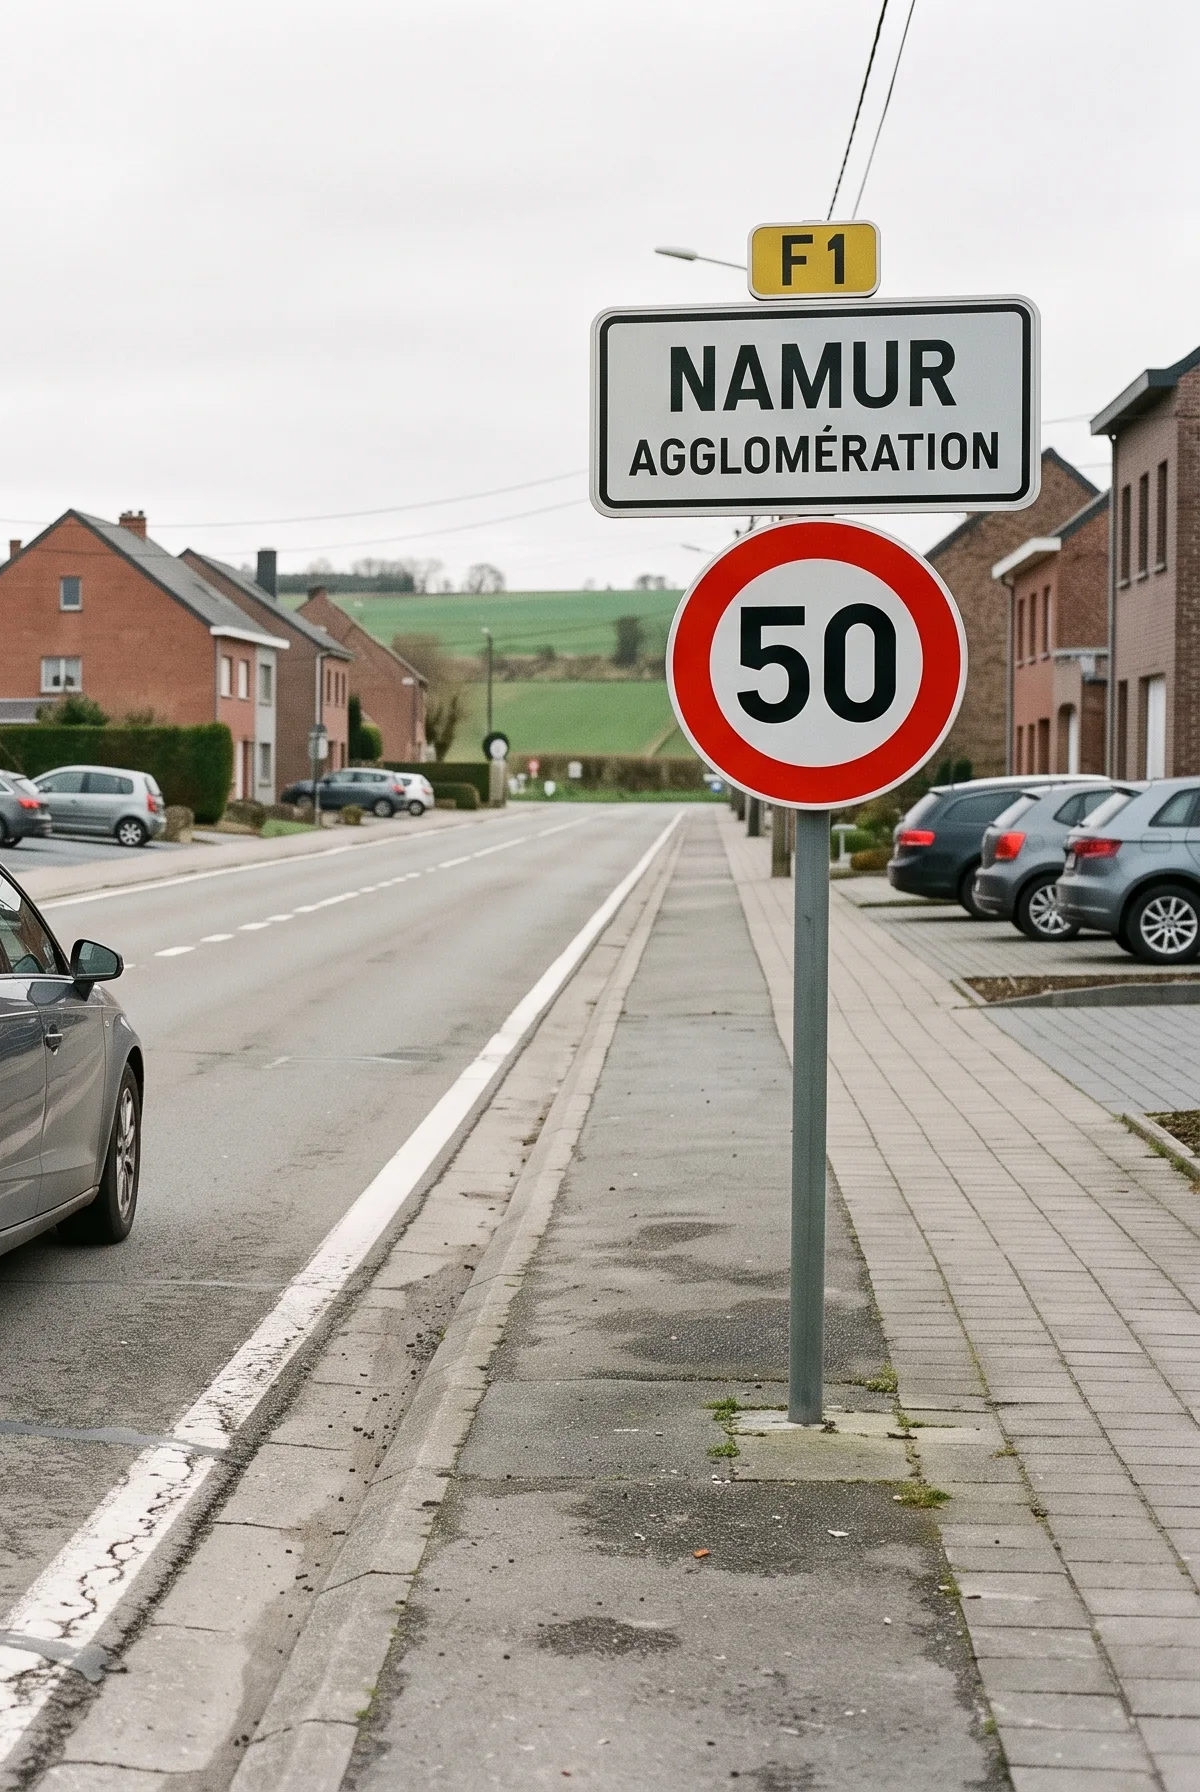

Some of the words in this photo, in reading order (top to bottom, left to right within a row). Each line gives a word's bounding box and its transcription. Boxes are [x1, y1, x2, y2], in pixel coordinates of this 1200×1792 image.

[670, 339, 957, 413] NAMUR
[628, 424, 999, 477] AGGLOMÉRATION
[737, 603, 897, 724] 50
